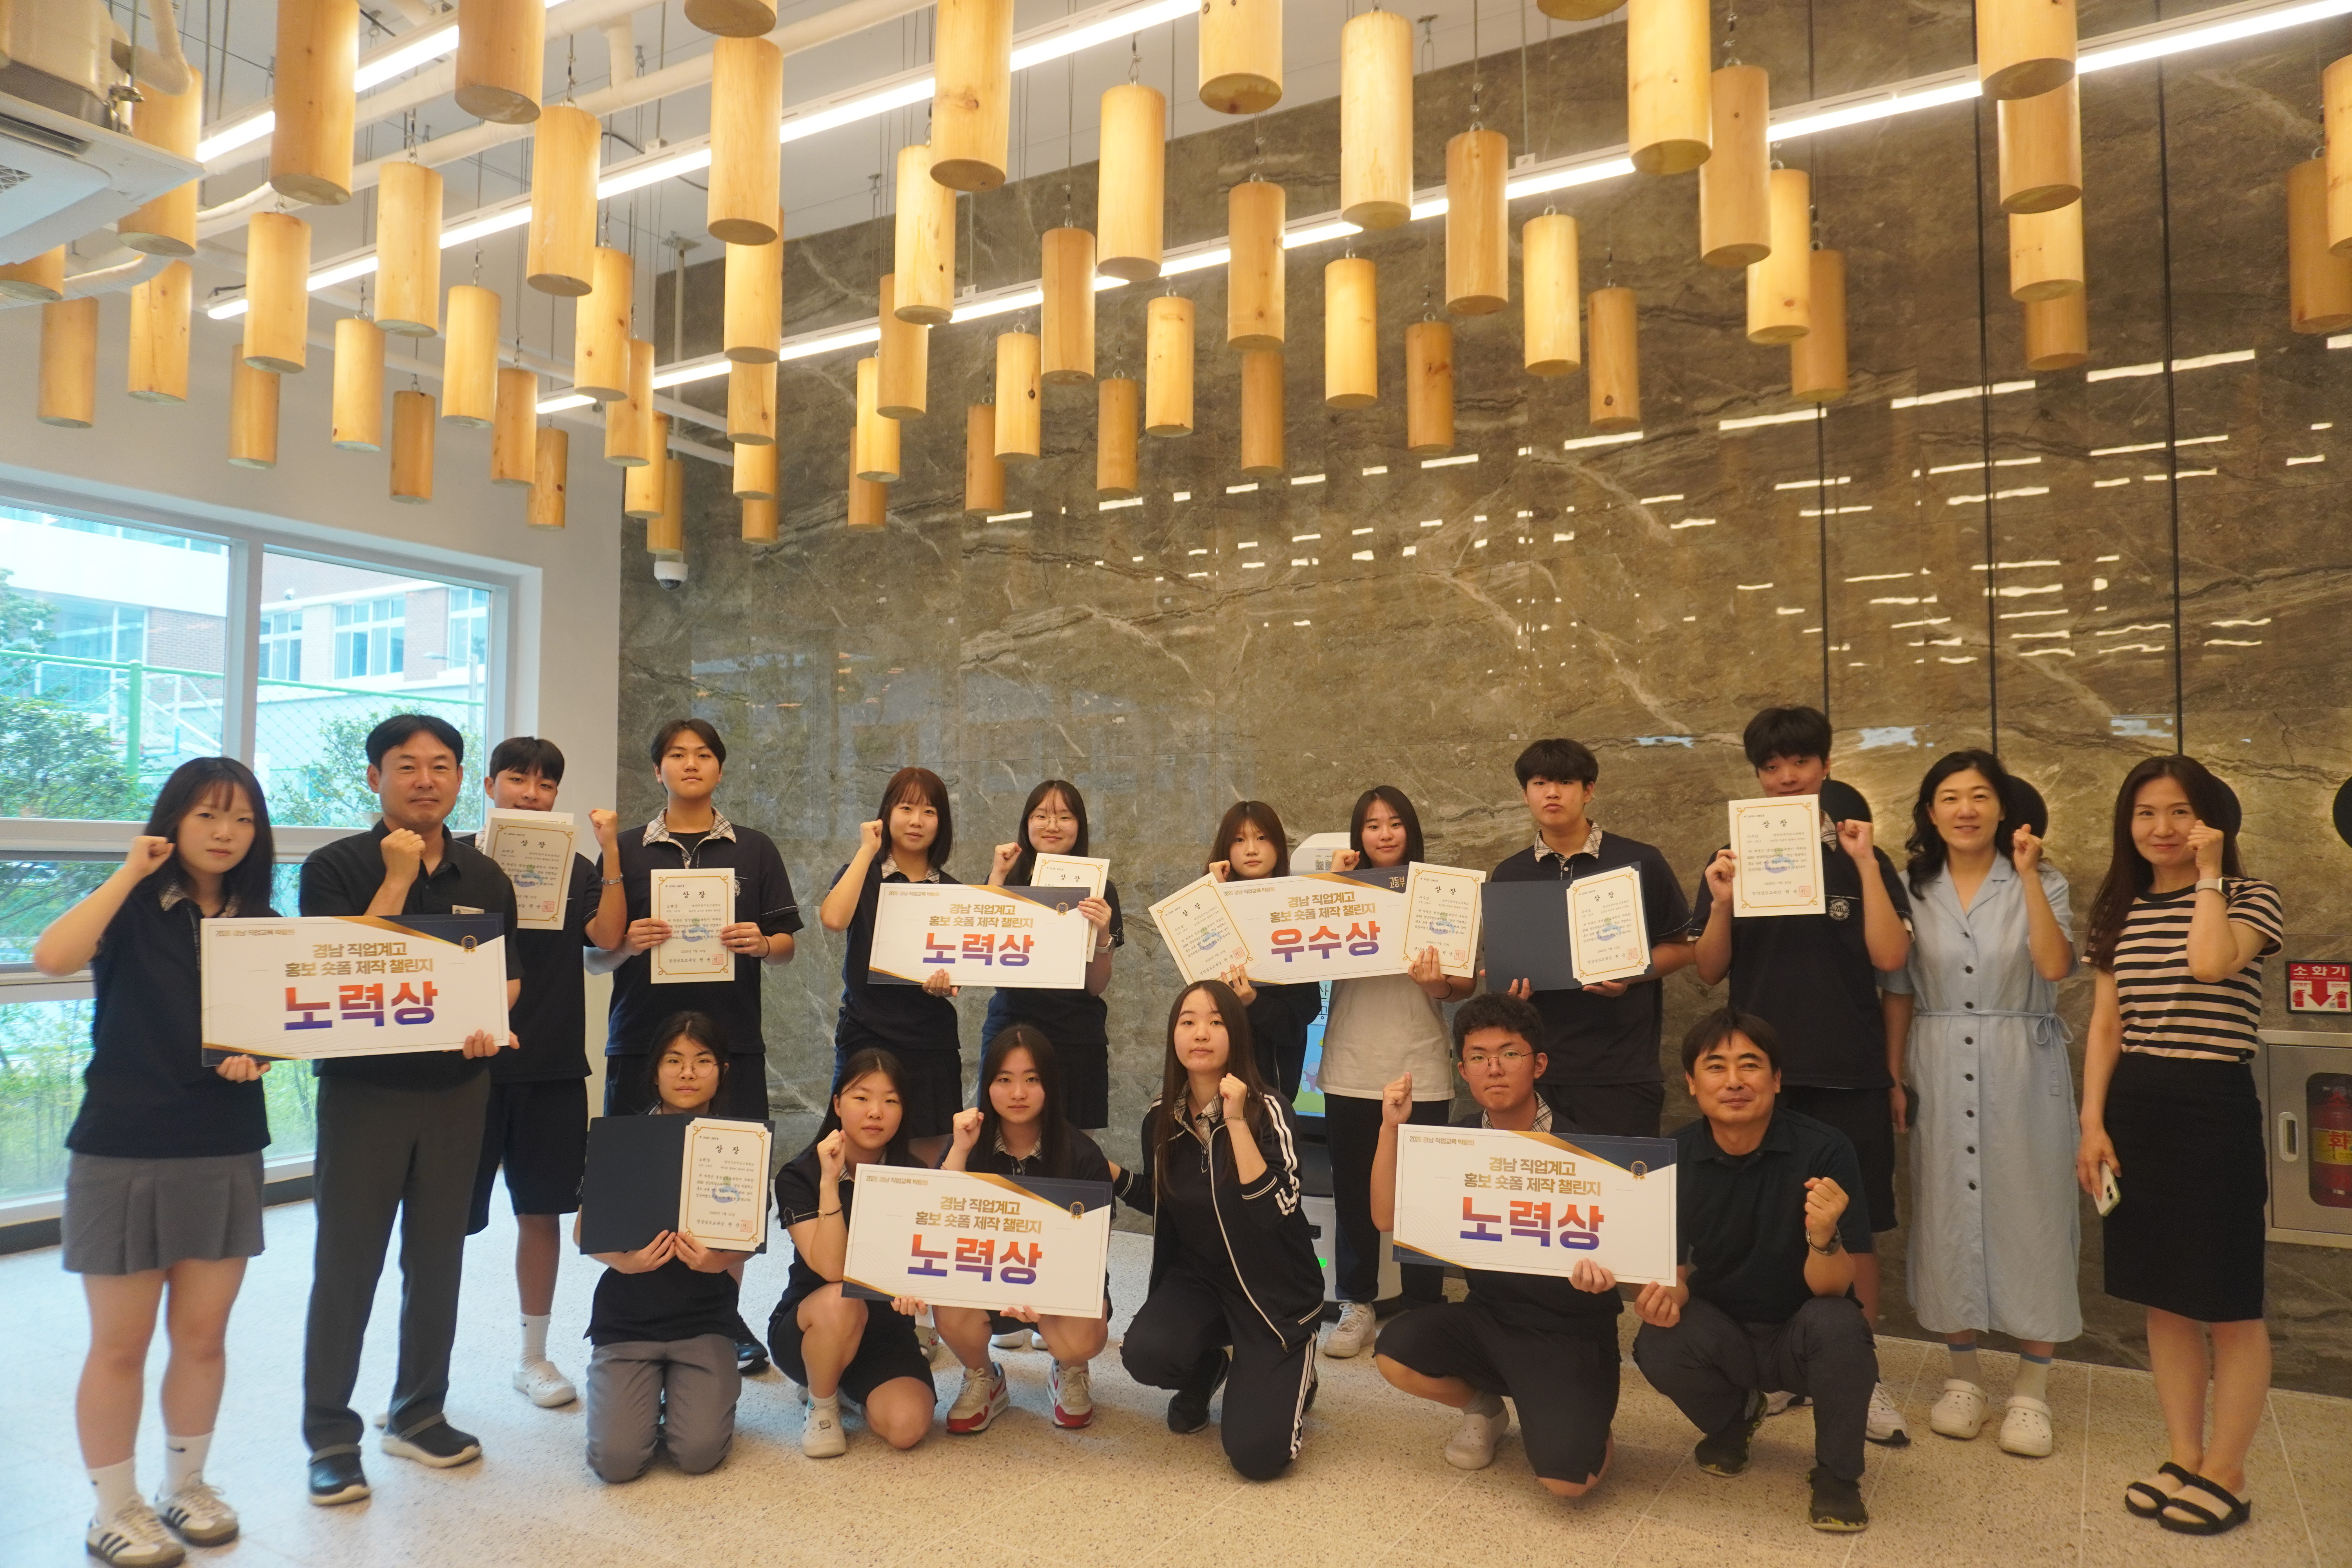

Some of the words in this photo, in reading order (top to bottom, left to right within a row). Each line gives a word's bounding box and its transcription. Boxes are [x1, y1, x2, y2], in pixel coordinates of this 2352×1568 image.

[1388, 876, 1405, 888] 고등부
[1288, 895, 1309, 908] 경남
[1312, 891, 1355, 905] 직업계고
[950, 904, 971, 914] 경남
[974, 904, 1015, 915] 직업계고
[1270, 911, 1292, 923] 홍보
[1294, 909, 1316, 921] 숏폼
[1319, 906, 1340, 918] 제작
[1343, 903, 1376, 916] 챌린지
[929, 916, 950, 926] 홍보
[953, 916, 974, 927] 숏폼
[977, 917, 999, 927] 제작
[1001, 917, 1033, 928] 챌린지
[313, 943, 344, 958] 경남
[348, 942, 407, 957] 직업계고
[923, 933, 1034, 966] 노력상
[1271, 921, 1380, 962] 우수상
[285, 962, 317, 977] 홍보
[321, 961, 351, 975] 숏폼
[356, 960, 386, 974] 제작
[389, 958, 433, 973] 챌린지
[2293, 966, 2346, 976] 소화기
[284, 981, 438, 1031] 노력상
[1489, 1157, 1517, 1172] 경남
[1520, 1159, 1576, 1176] 직업계고
[1465, 1173, 1491, 1188] 홍보
[1495, 1175, 1523, 1191] 숏폼
[1527, 1178, 1555, 1193] 제작
[1559, 1179, 1601, 1196] 챌린지
[940, 1196, 967, 1211] 경남
[969, 1199, 1020, 1215] 직업계고
[916, 1211, 941, 1226] 홍보
[944, 1214, 971, 1228] 숏폼
[973, 1216, 1000, 1230] 제작
[1003, 1218, 1042, 1234] 챌린지
[1460, 1197, 1604, 1250] 노력상
[907, 1234, 1042, 1285] 노력상
